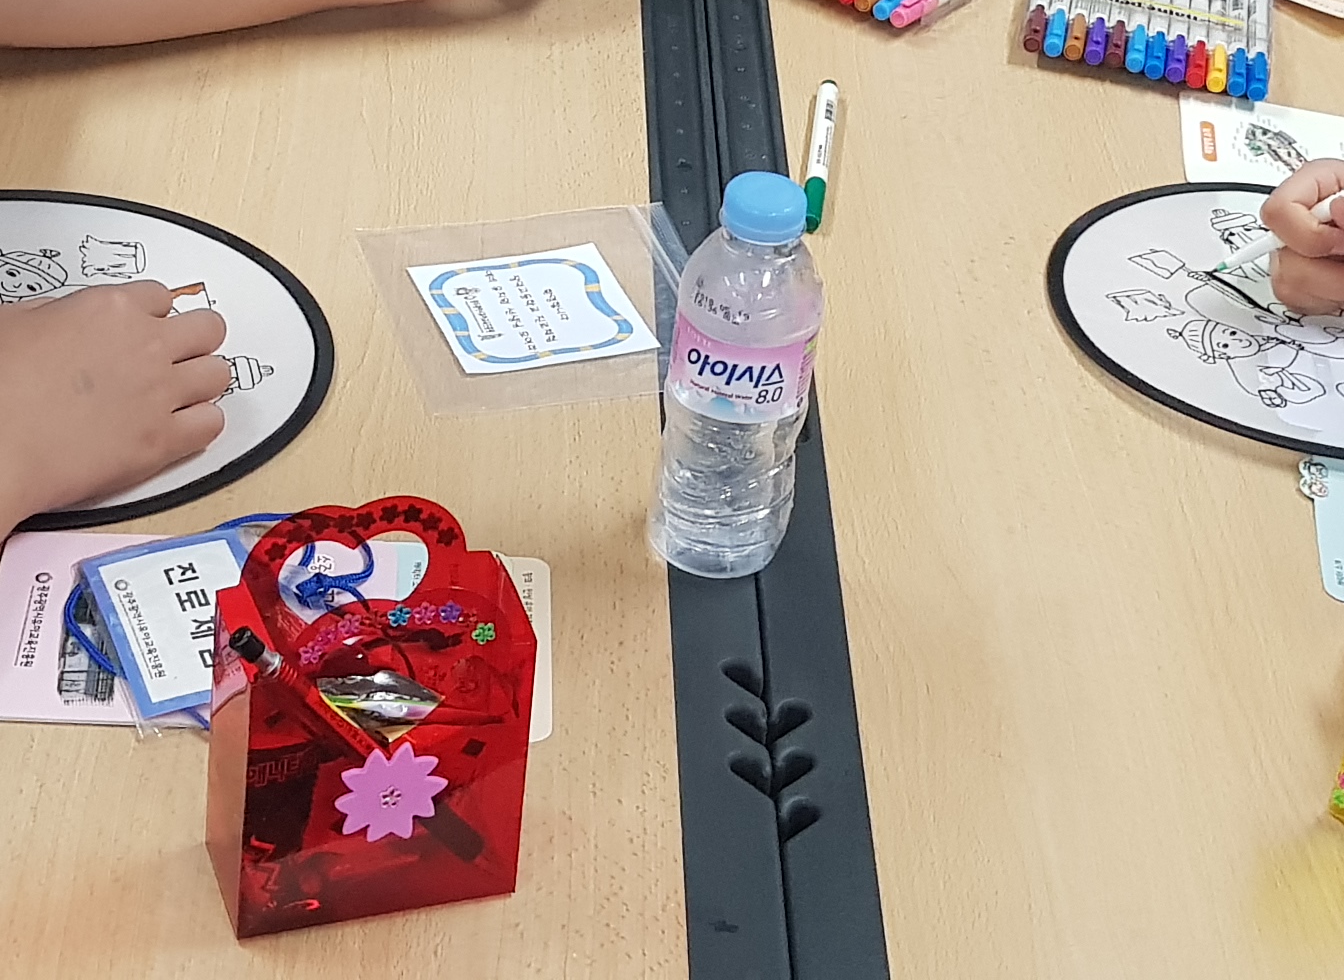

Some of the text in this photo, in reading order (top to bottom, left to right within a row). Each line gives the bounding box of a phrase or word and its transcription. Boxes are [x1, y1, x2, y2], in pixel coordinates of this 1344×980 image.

[505, 308, 525, 328] 선생님
[688, 347, 785, 389] 아이시스
[755, 386, 783, 405] 8.0
[20, 585, 50, 667] 광주광역시유아교육진흥원
[121, 590, 167, 680] 광주광역시유아교육진흥원
